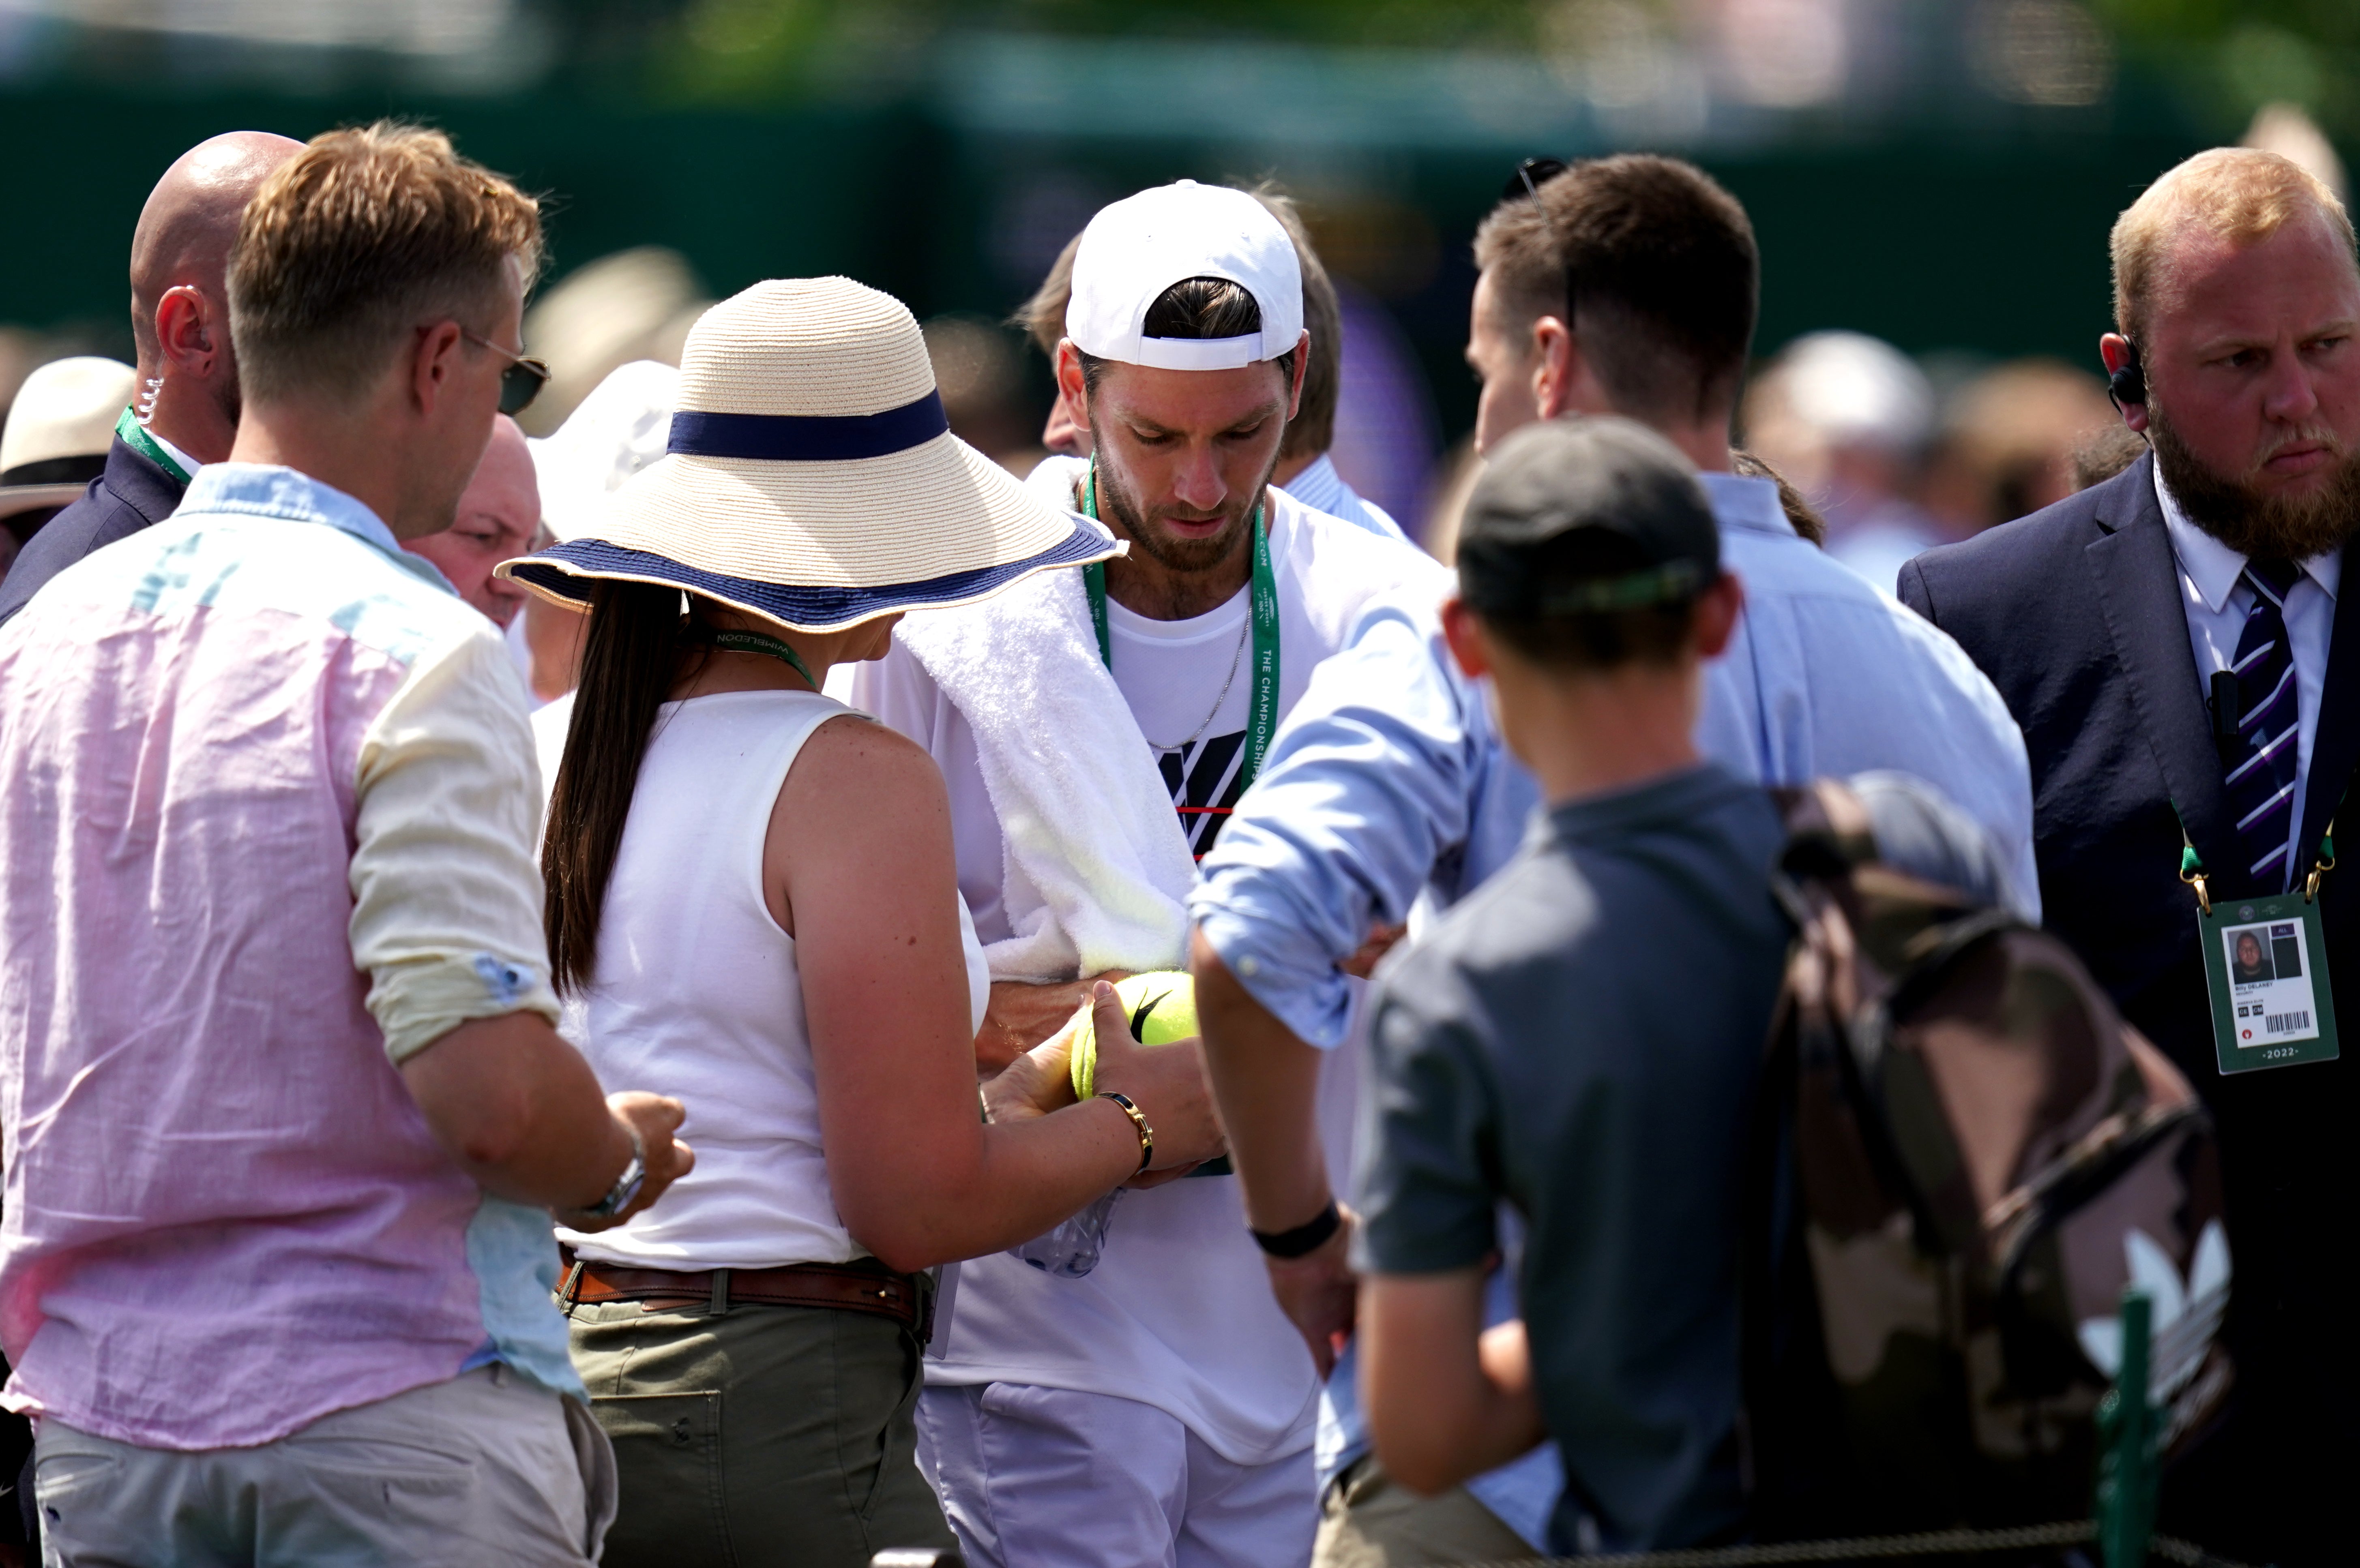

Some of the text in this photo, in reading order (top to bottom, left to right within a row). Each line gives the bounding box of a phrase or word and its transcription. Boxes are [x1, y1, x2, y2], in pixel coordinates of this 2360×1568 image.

[717, 634, 789, 655] WIMBLEDON
[1251, 650, 1271, 781] THE CHAMPIONSHIPS
[2248, 982, 2273, 990] DELANEY
